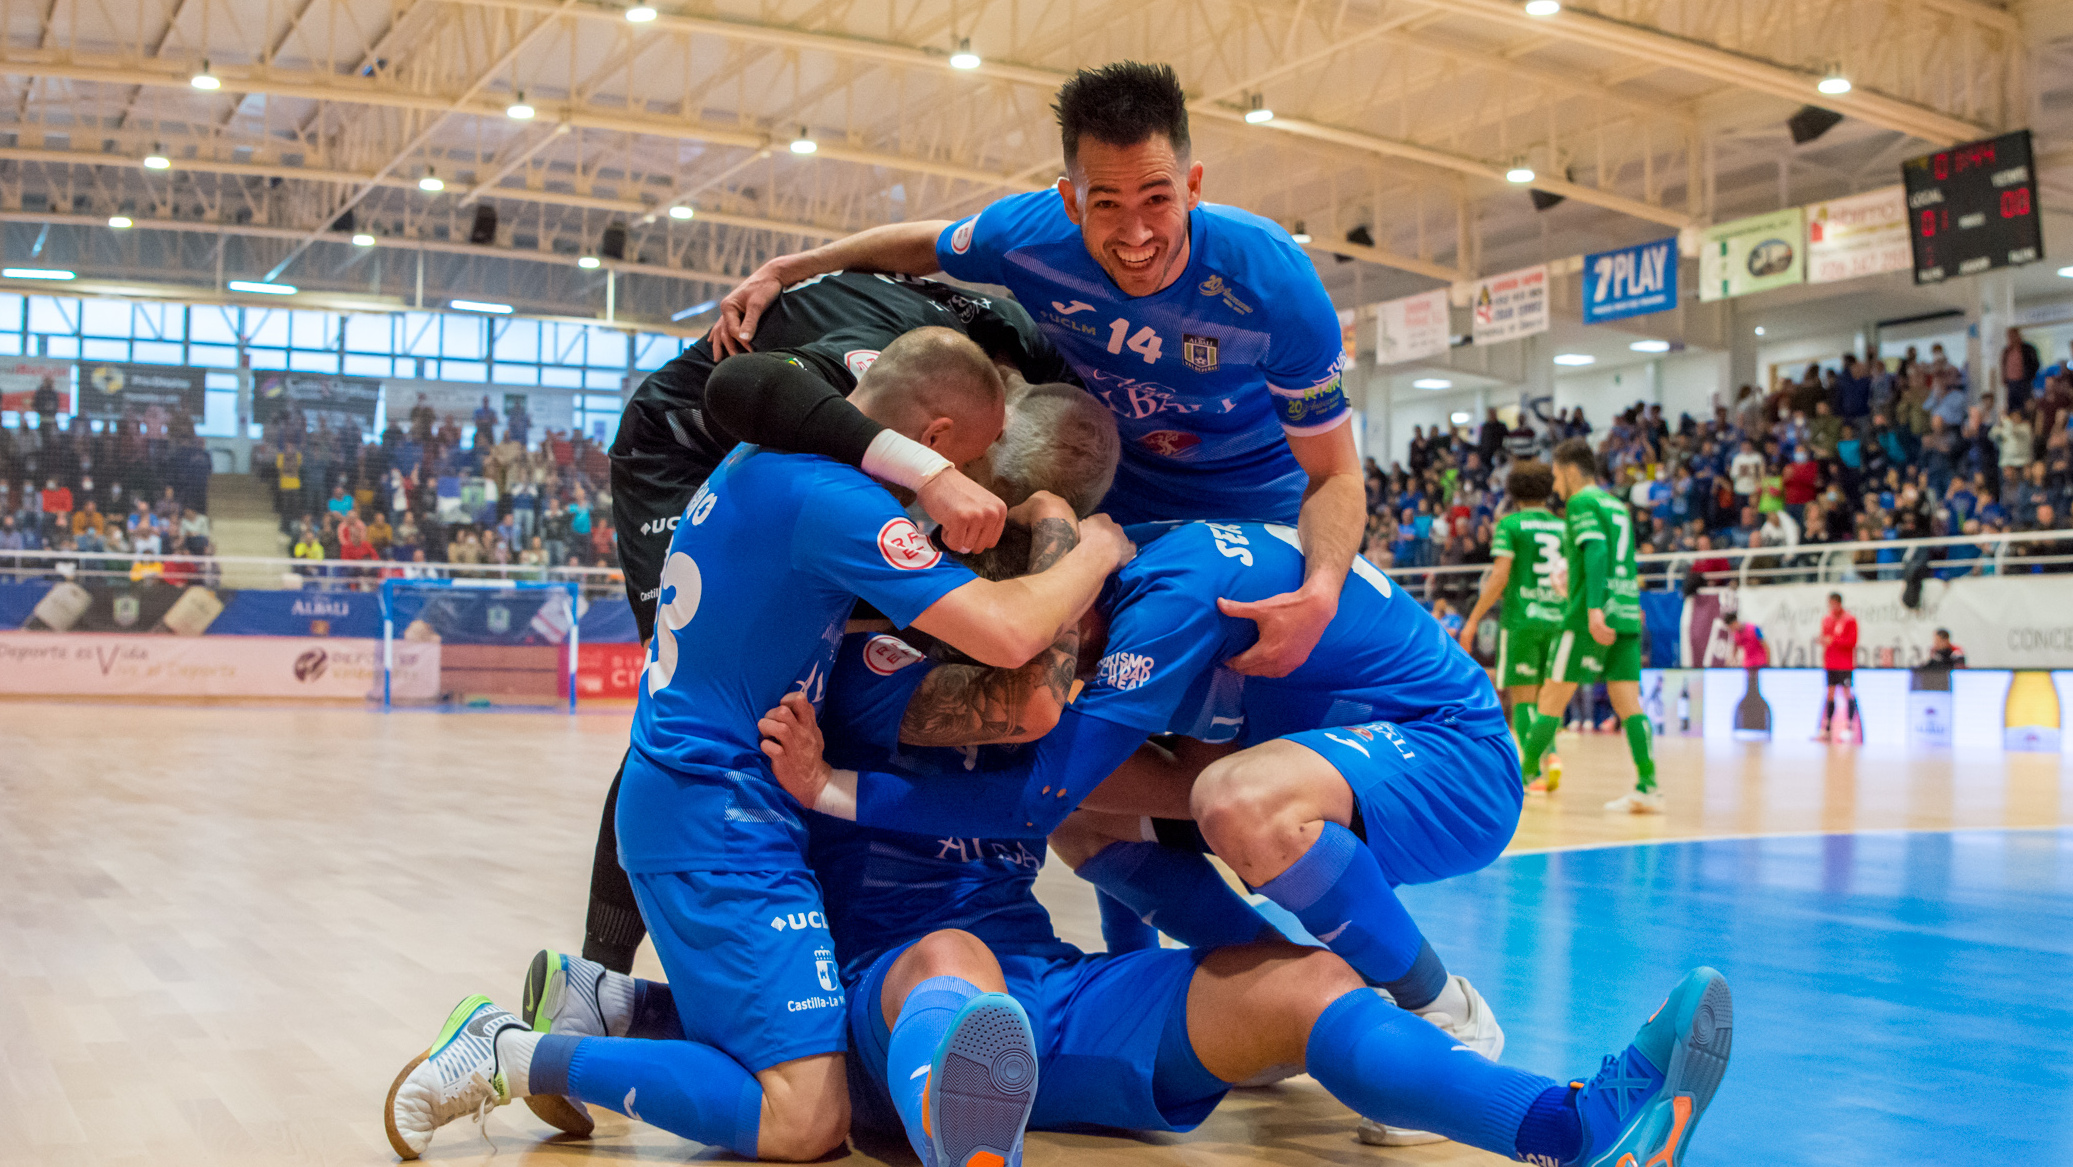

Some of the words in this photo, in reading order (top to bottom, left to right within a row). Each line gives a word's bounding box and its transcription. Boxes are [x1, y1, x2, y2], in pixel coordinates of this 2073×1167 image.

[1050, 313, 1097, 336] UCLM
[1106, 317, 1163, 364] 14
[788, 996, 838, 1012] Castilla-La
